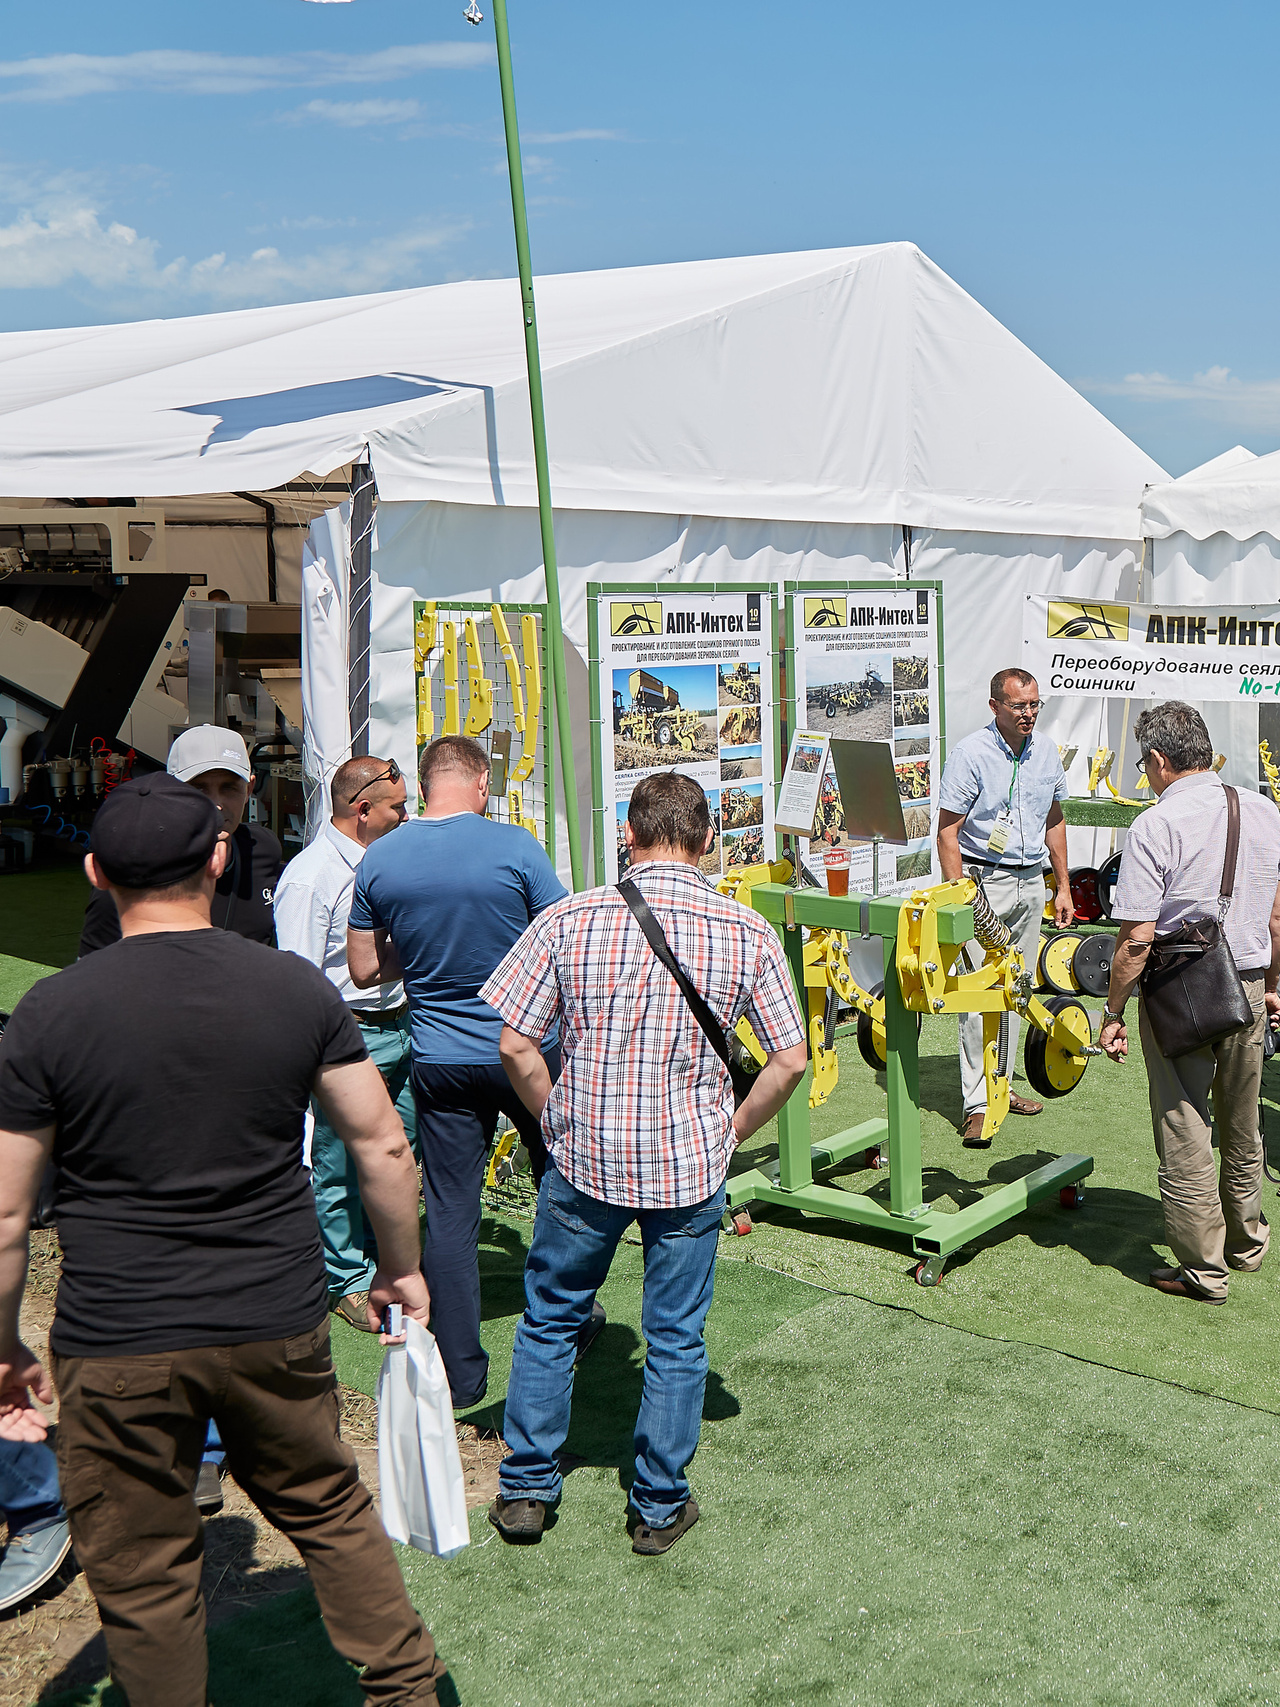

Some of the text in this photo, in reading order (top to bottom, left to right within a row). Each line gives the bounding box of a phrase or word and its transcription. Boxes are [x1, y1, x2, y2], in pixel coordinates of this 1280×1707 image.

[749, 608, 759, 617] 10
[918, 603, 927, 612] 10
[666, 612, 744, 634] АПК-Интех
[850, 606, 914, 627] АПК-Интех
[611, 642, 656, 652] ПРОЕКТИРОВАНИЕ
[661, 640, 697, 650] ИЗГОТОВЛЕНИЕ
[697, 640, 722, 649] СОШНИКОВ
[723, 639, 744, 648] ПРЯМОГО
[744, 638, 761, 647] ПОСЕВА
[1050, 654, 1233, 675] Переоборудование
[1050, 674, 1136, 691] Сошники
